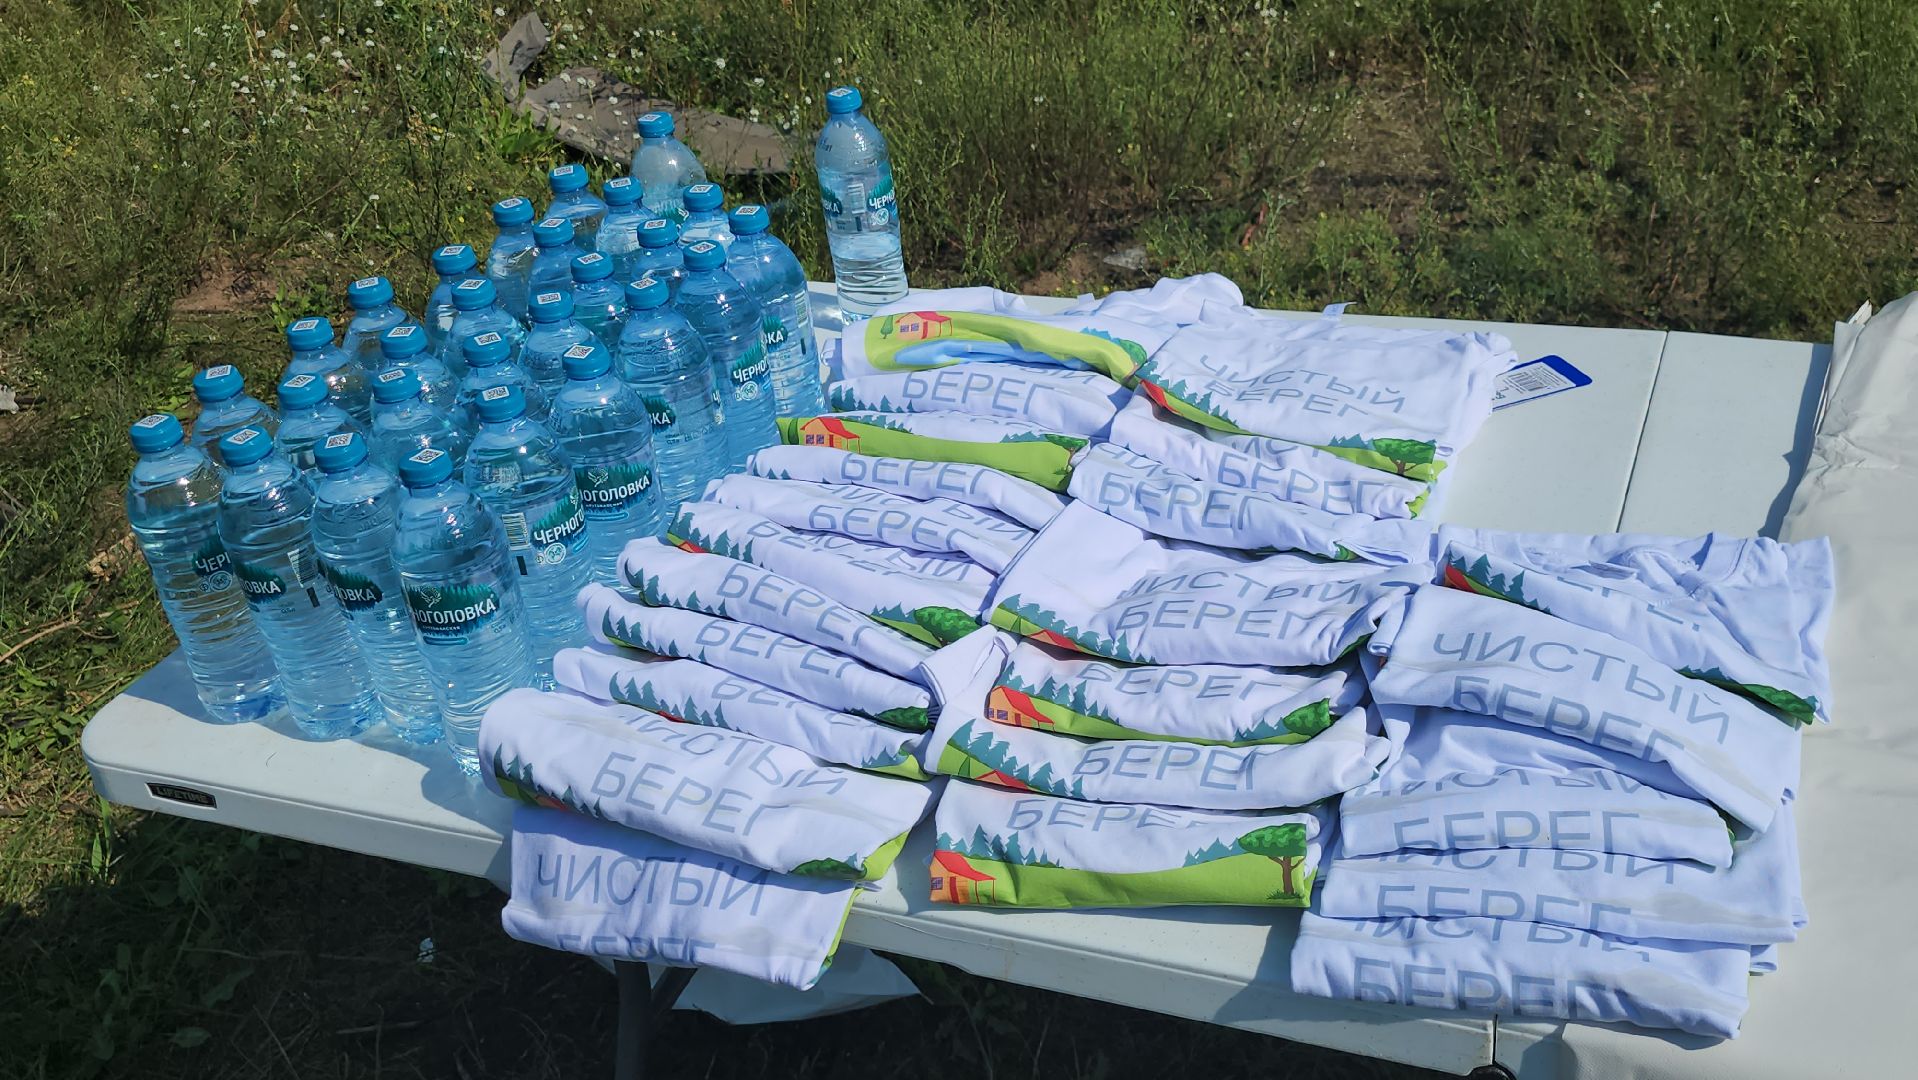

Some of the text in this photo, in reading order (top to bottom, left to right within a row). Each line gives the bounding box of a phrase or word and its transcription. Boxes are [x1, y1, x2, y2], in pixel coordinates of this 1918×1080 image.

[902, 371, 1054, 416] БЕРЕГ
[1200, 354, 1406, 413] ЧИСТЫЙ
[1204, 379, 1369, 417] БЕРЕГ
[841, 452, 996, 495] БЕРЕГ
[1100, 472, 1253, 531] БЕРЕГ
[808, 504, 980, 551] БЕРЕГ
[716, 563, 870, 647] БЕРЕГ
[1116, 571, 1362, 607] ЧИСТЫЙ
[1116, 600, 1310, 640] БЕРЕГ
[696, 619, 856, 679] БЕРЕГ
[1076, 663, 1283, 702] БЕРЕГ
[1432, 632, 1730, 745] ЧИСТЫЙ
[1453, 675, 1685, 762] БЕРЕГ
[622, 714, 848, 795] ЧИСТЫЙ
[1073, 744, 1268, 791] БЕРЕГ
[591, 751, 790, 837] БЕРЕГ
[1393, 810, 1640, 856] БЕРЕГ
[537, 853, 772, 917] ЧИСТЫЙ
[1376, 884, 1632, 938] БЕРЕГ
[1352, 956, 1606, 1020] БЕРЕГ
